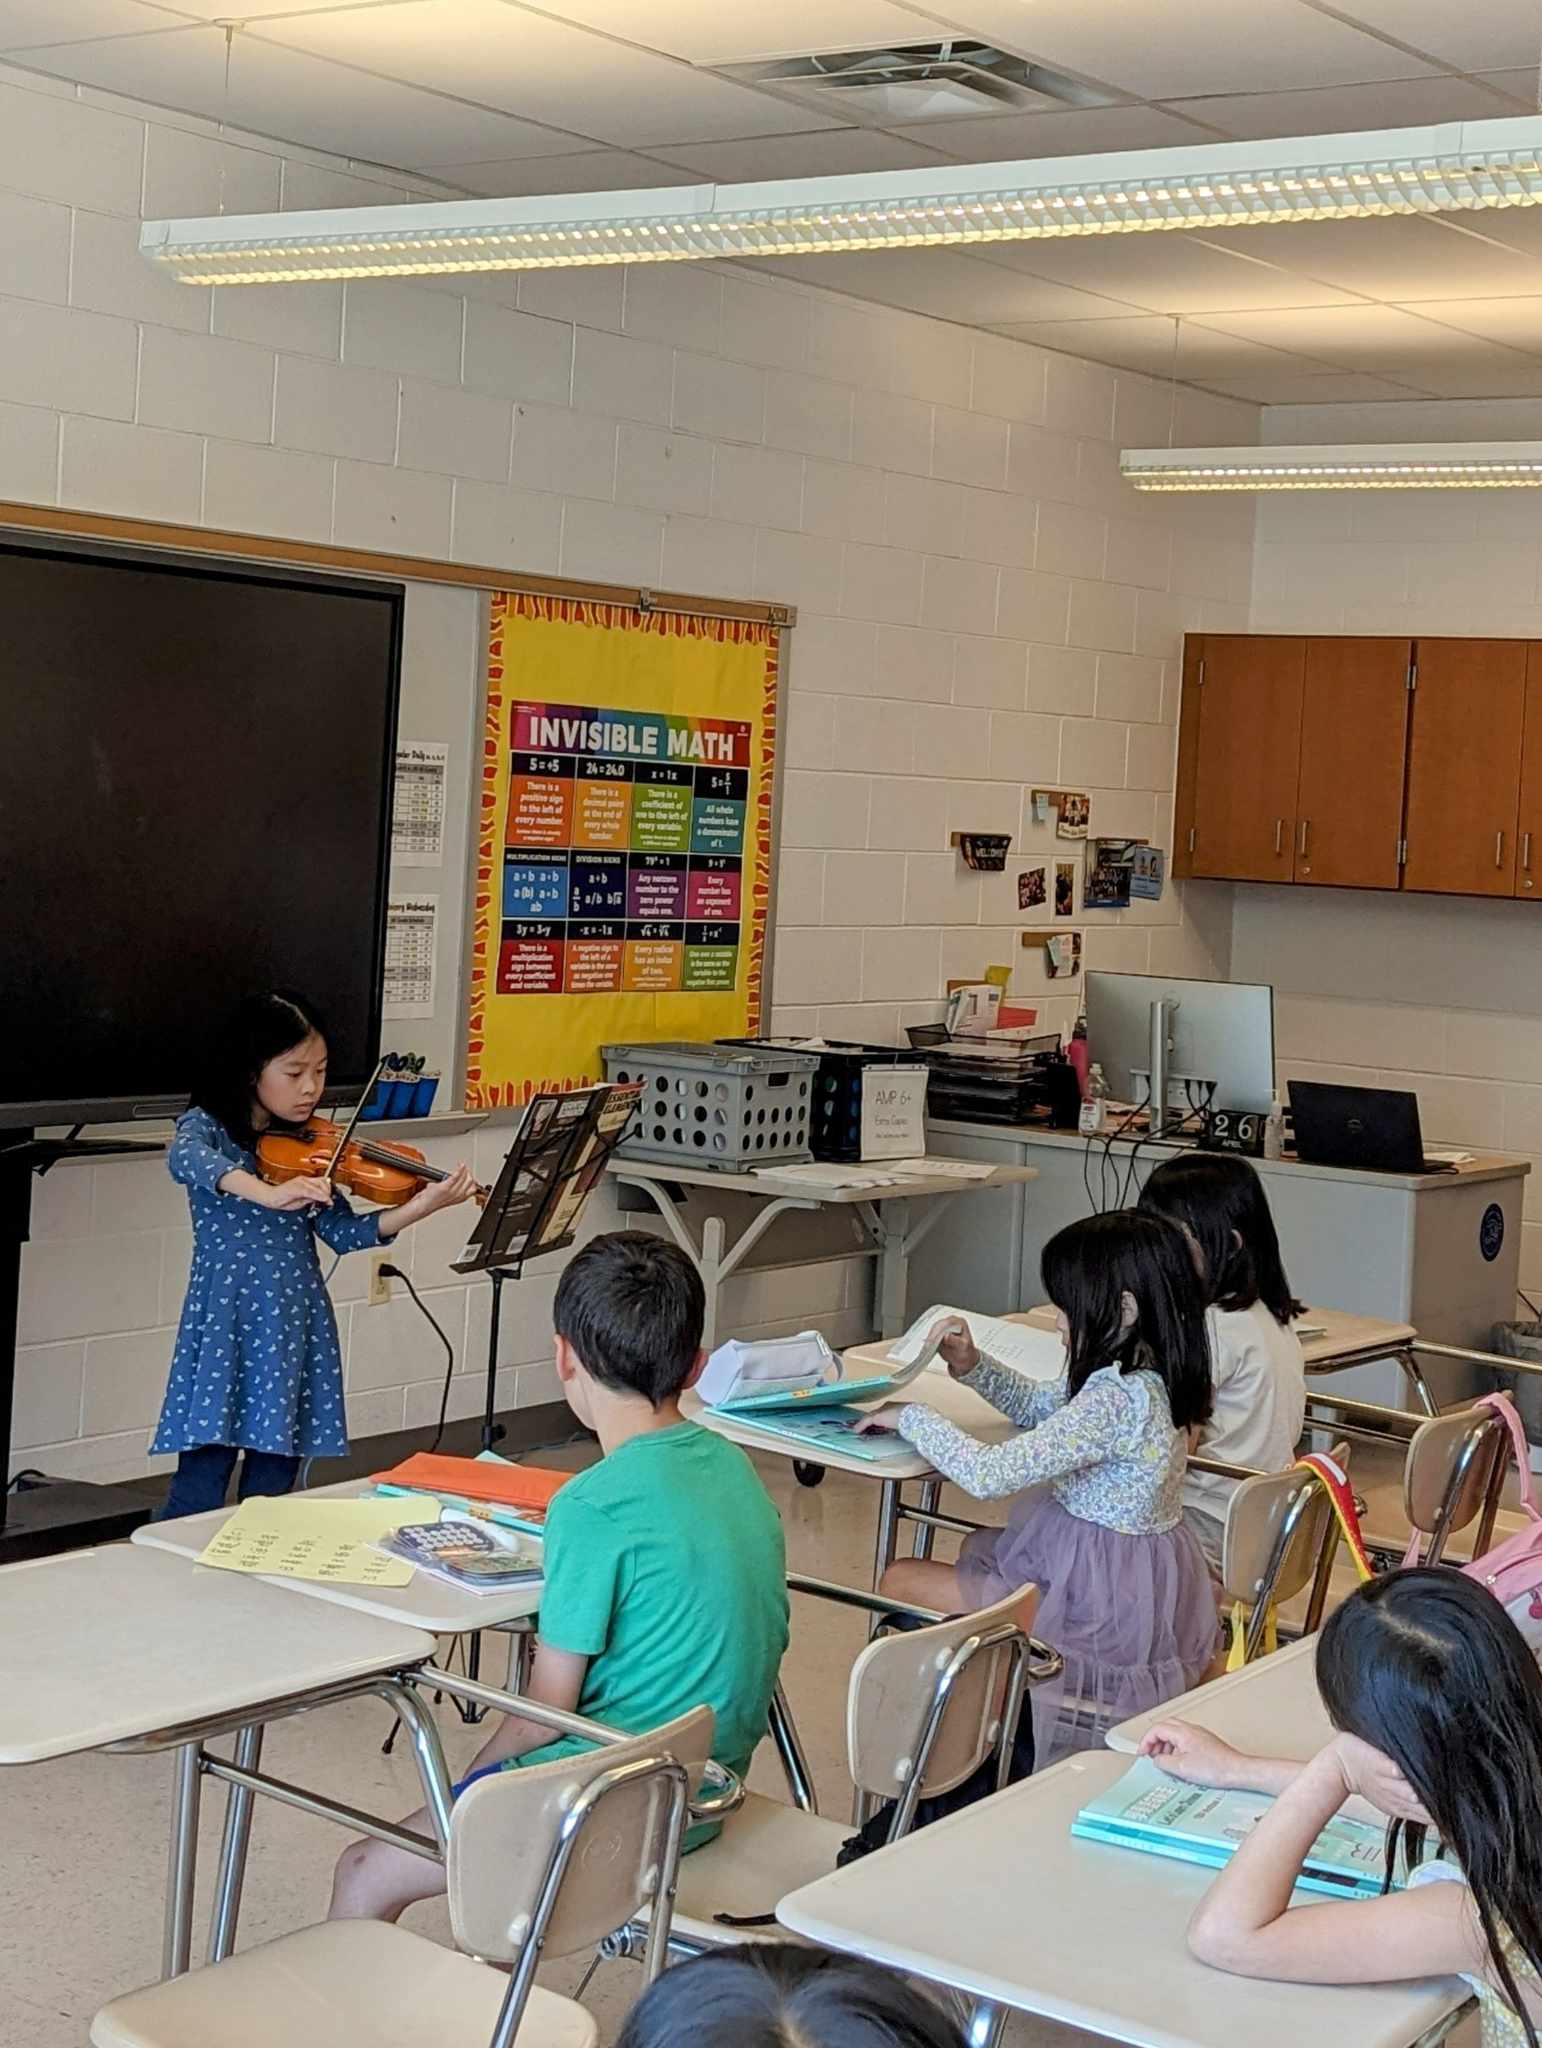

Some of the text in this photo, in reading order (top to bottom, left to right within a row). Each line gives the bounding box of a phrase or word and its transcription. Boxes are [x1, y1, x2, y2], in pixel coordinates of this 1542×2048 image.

[530, 716, 734, 761] INVISIBLE MATH
[529, 757, 538, 771] 5
[586, 762, 598, 774] 24
